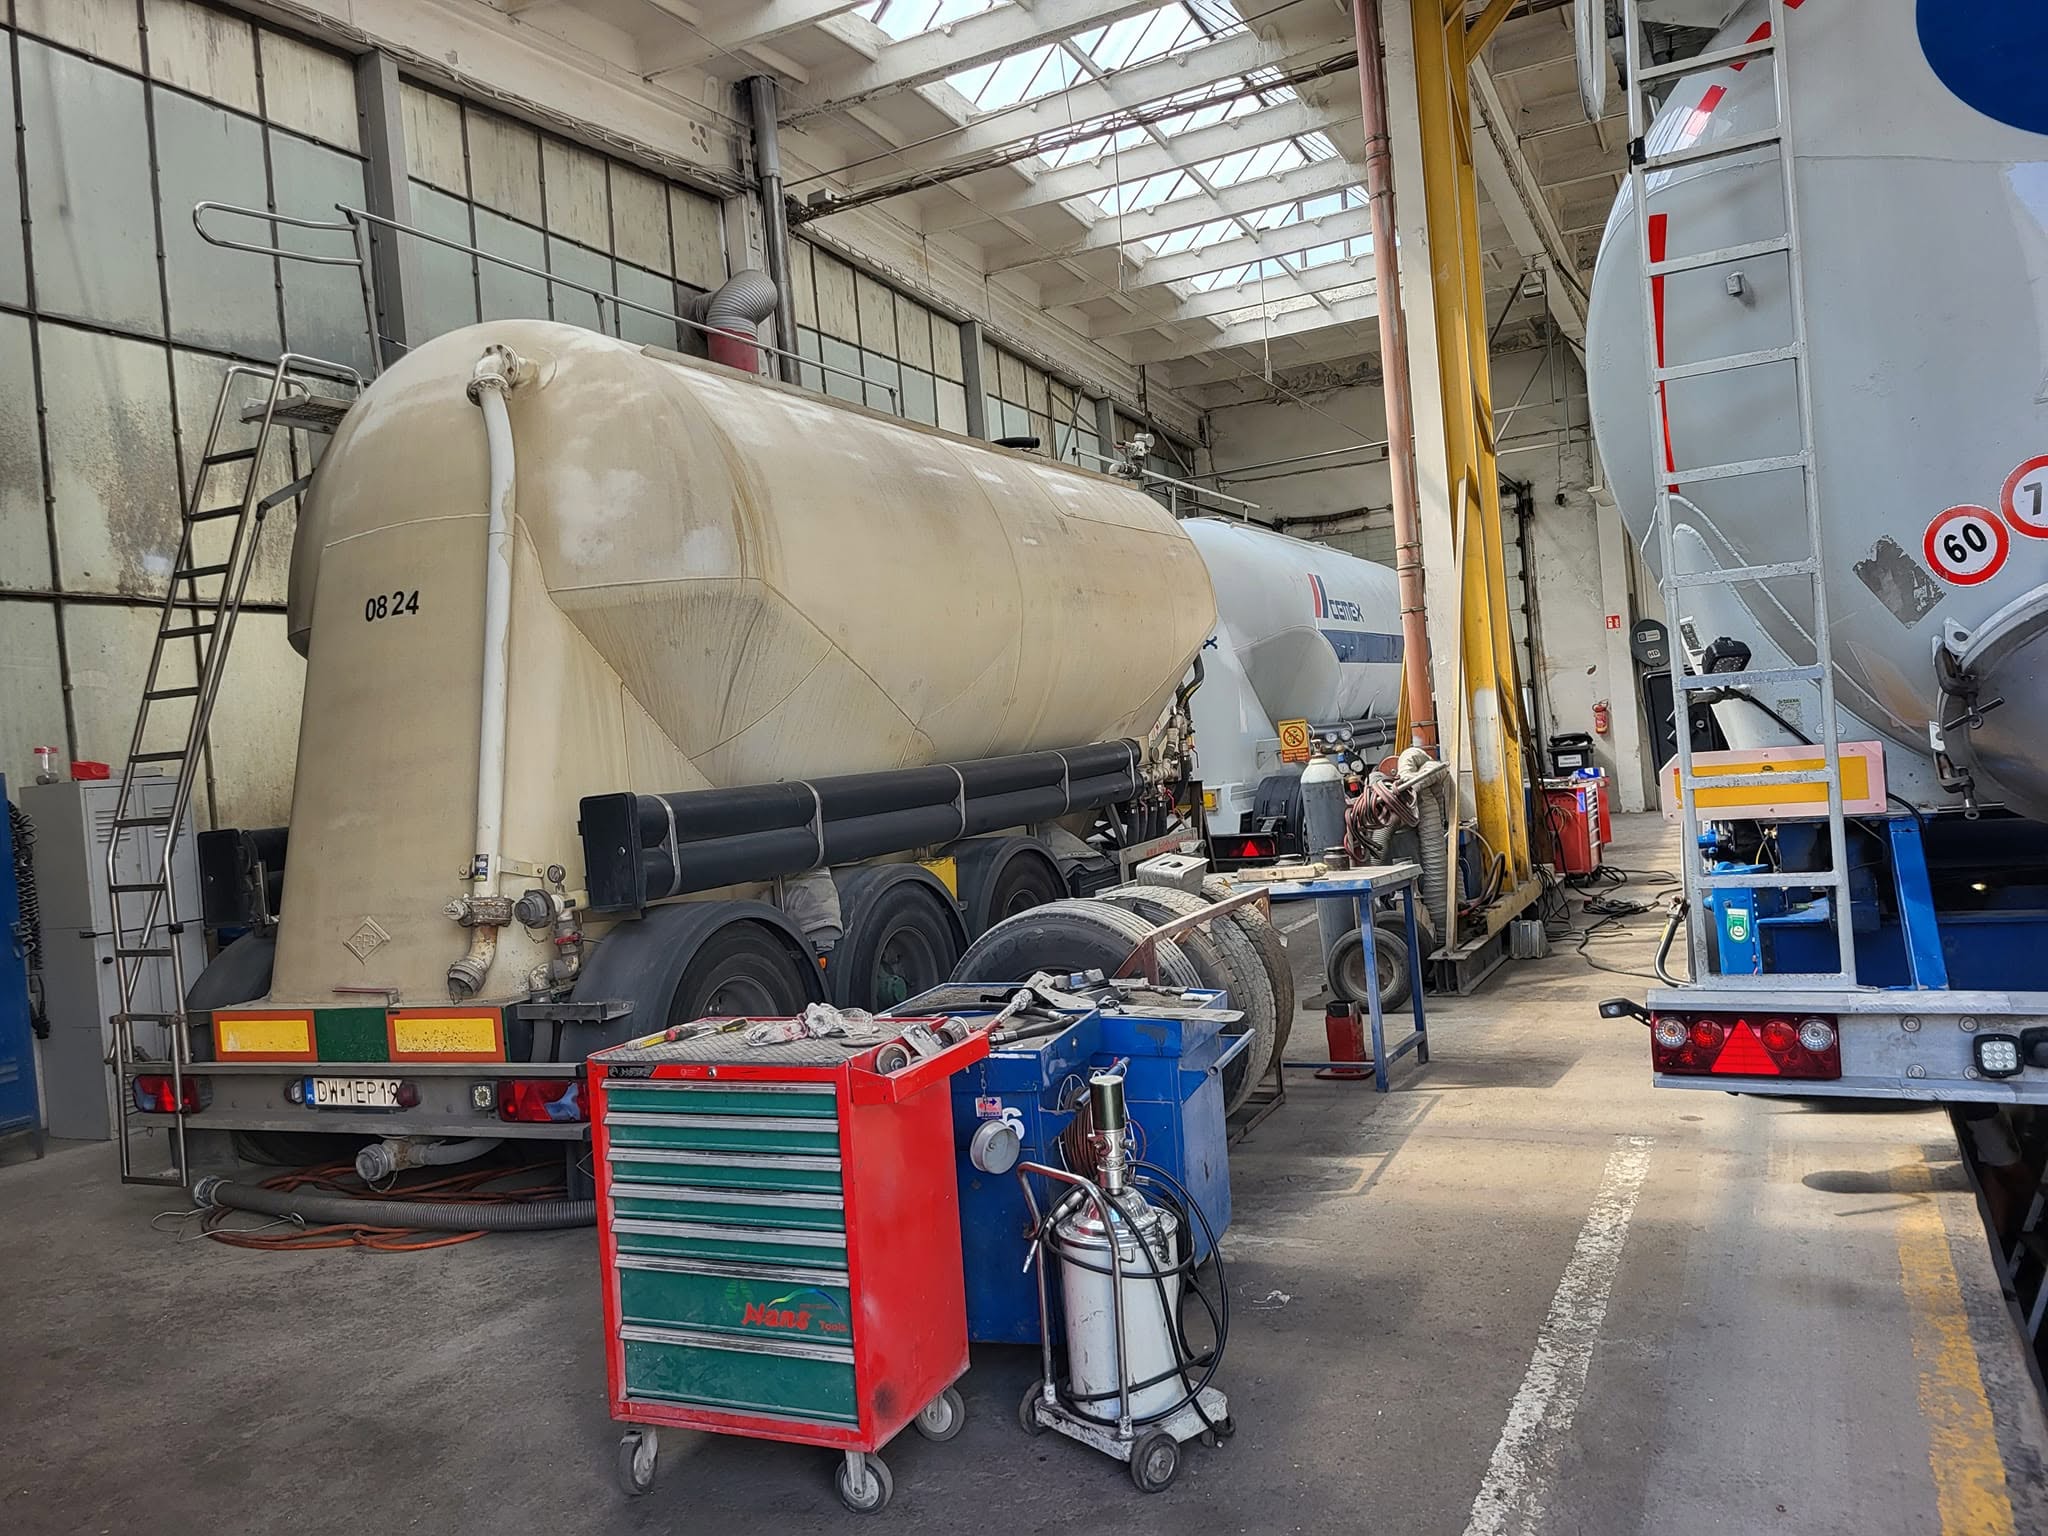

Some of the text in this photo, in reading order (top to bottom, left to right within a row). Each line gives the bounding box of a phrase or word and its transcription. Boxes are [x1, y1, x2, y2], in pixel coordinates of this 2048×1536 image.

[1944, 523, 1987, 563] 60
[1328, 599, 1364, 622] CEMEX
[317, 1080, 338, 1102] DW
[819, 1320, 848, 1332] Tools
